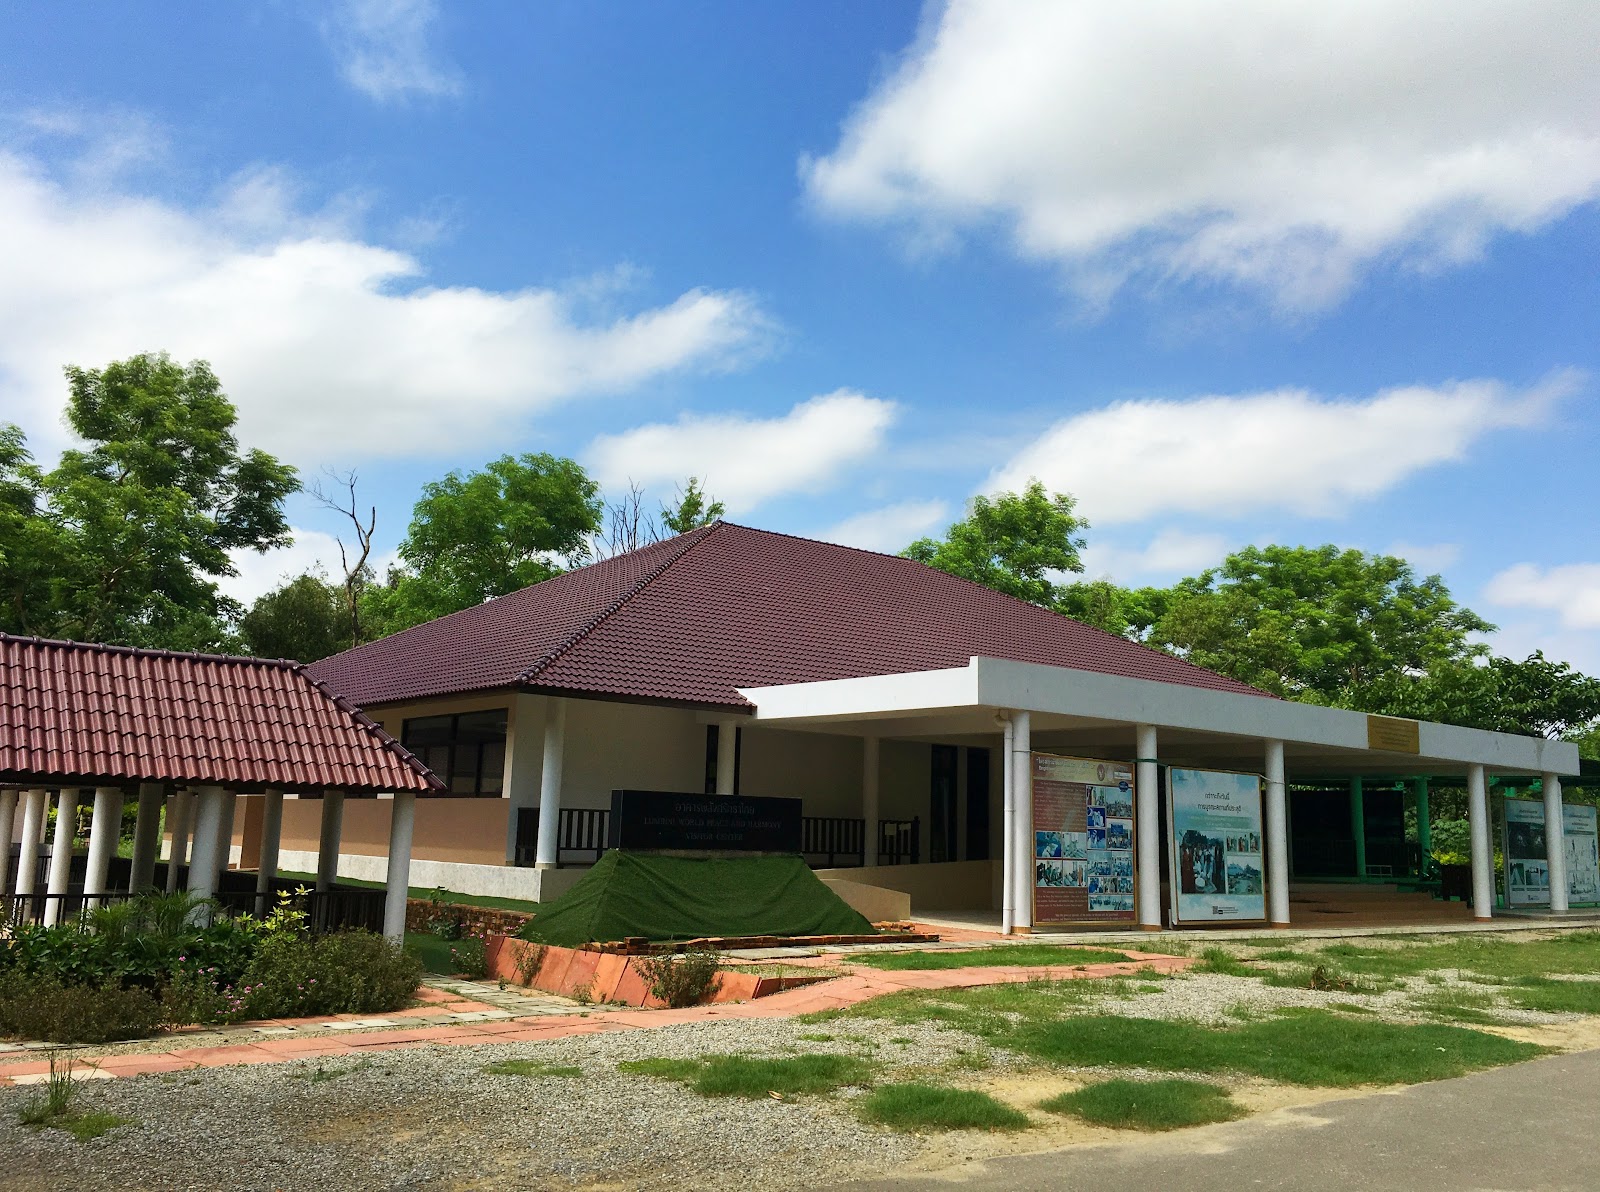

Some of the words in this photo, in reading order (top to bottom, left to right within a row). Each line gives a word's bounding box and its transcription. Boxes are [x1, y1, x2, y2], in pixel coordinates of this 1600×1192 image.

[679, 817, 704, 826] WORLD
[748, 820, 782, 829] HARMONY
[685, 831, 713, 840] VISITOR
